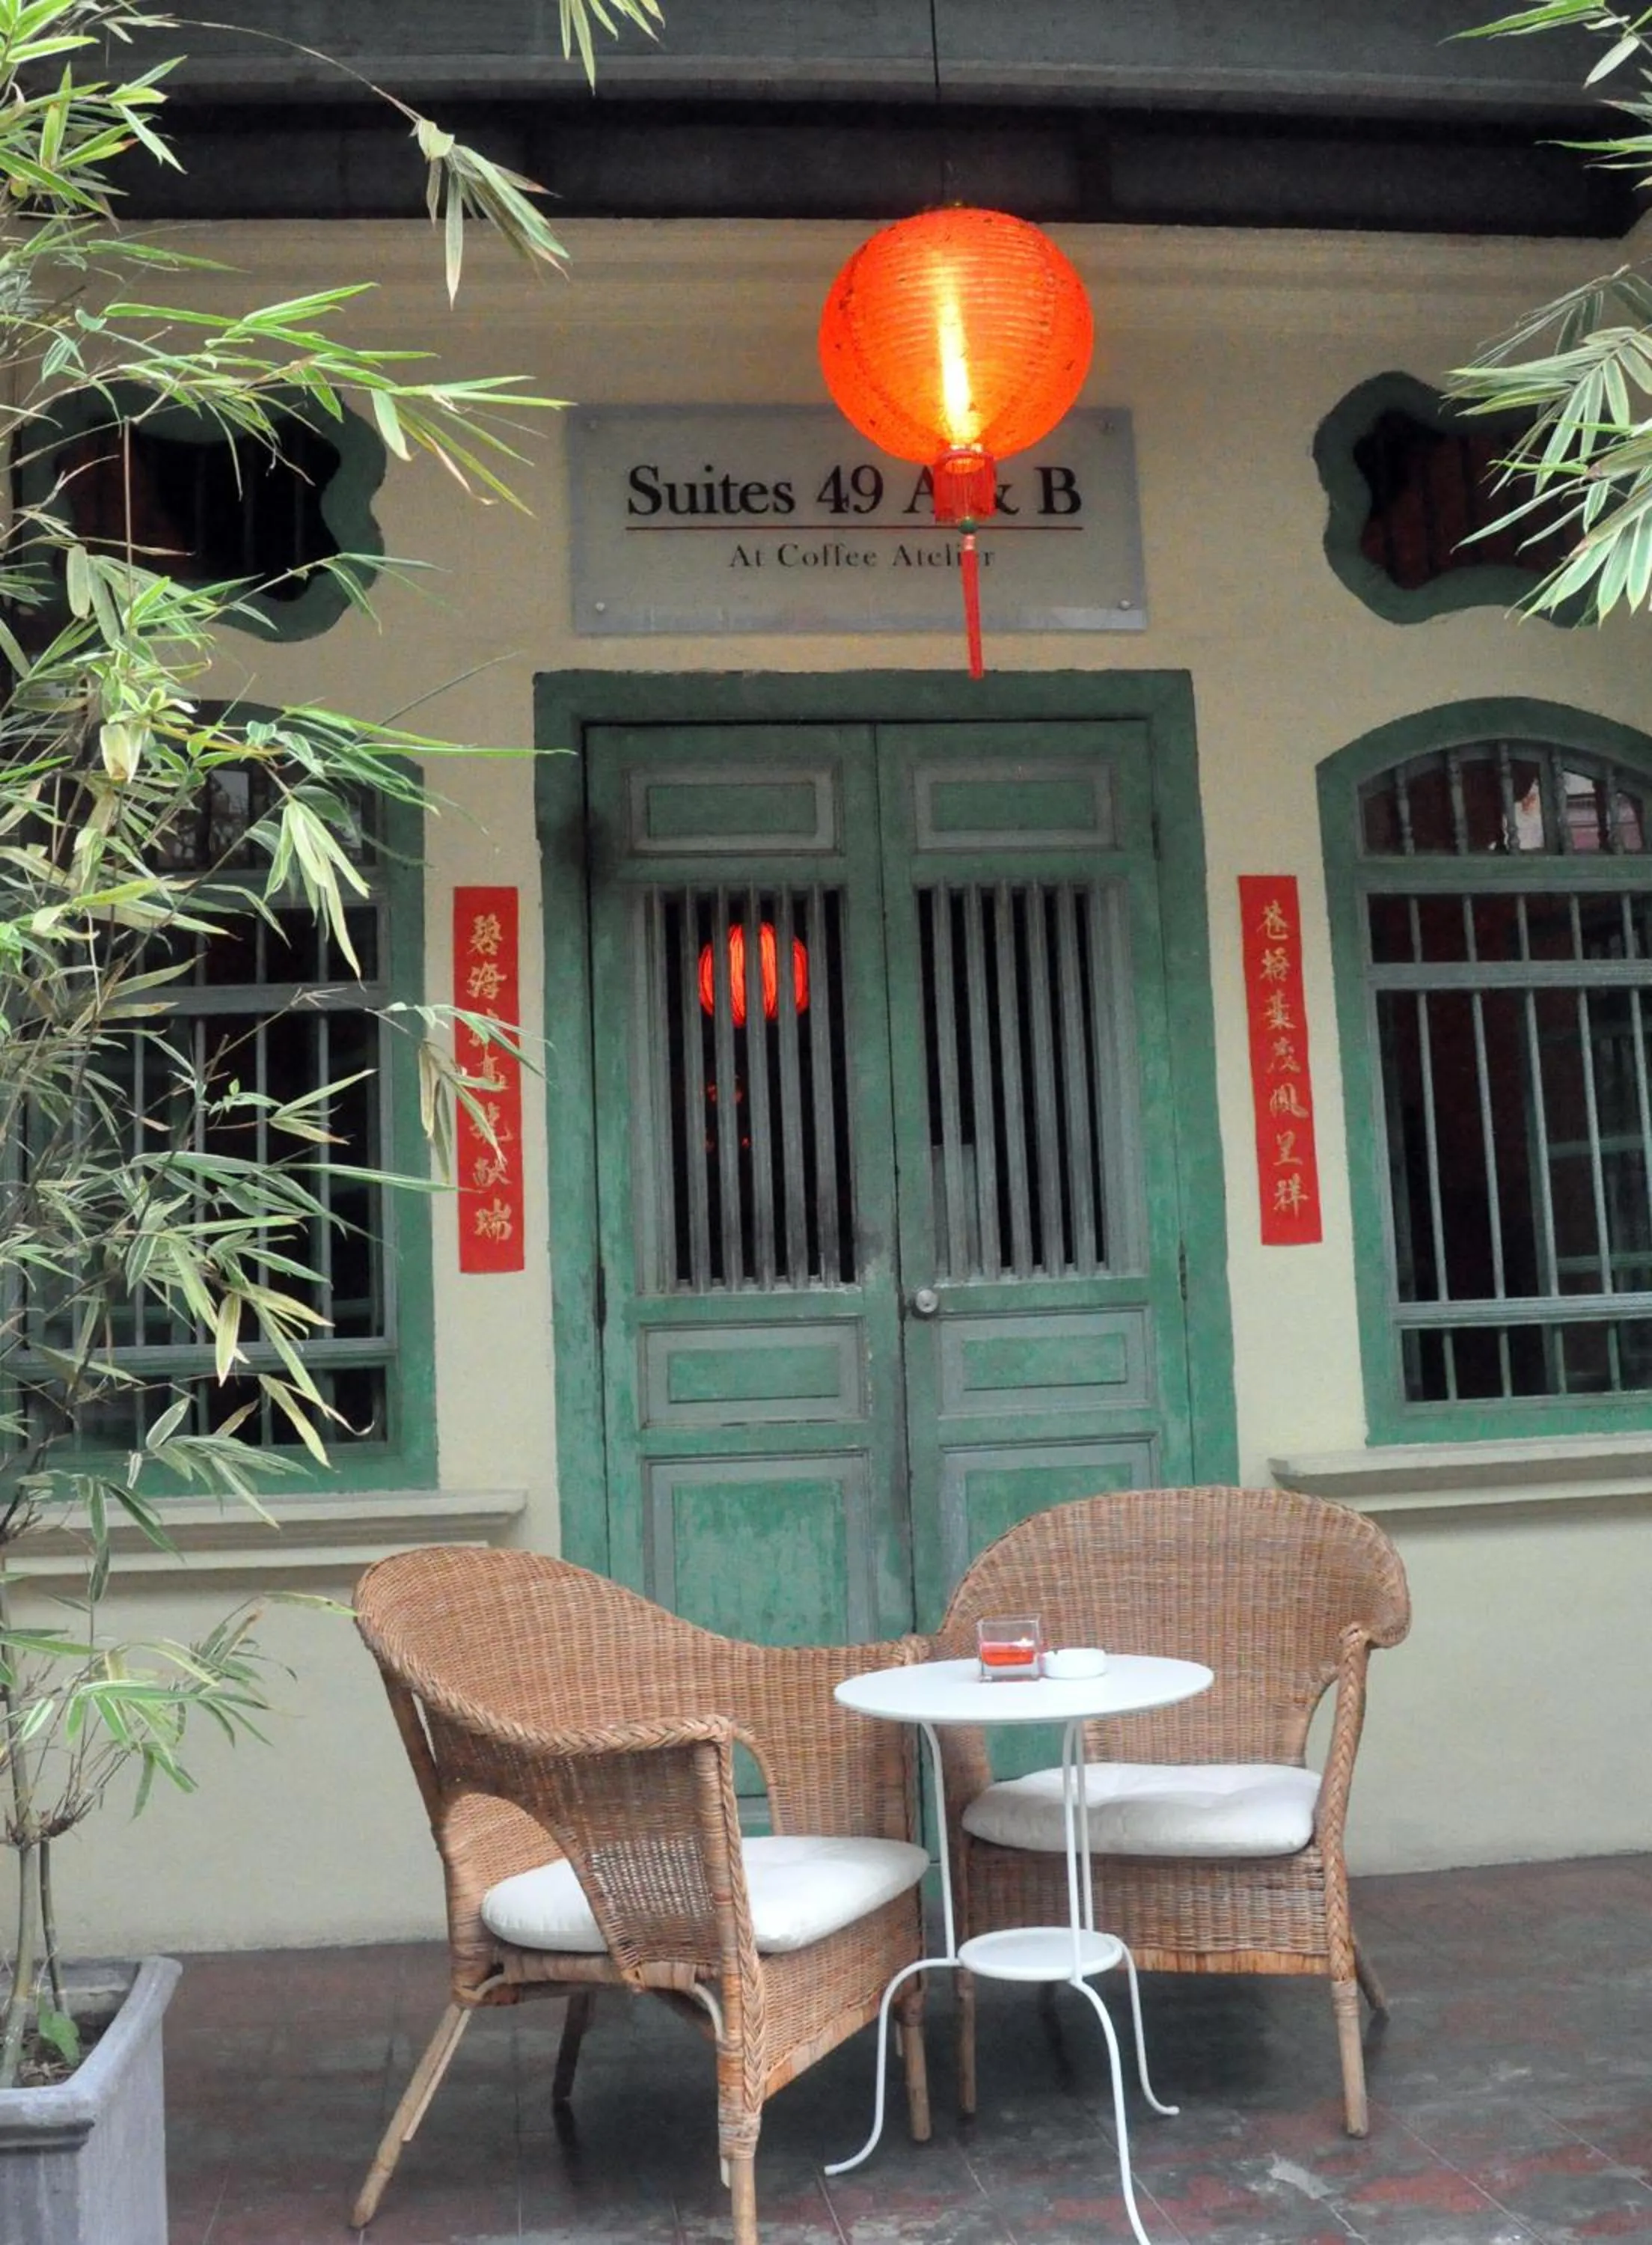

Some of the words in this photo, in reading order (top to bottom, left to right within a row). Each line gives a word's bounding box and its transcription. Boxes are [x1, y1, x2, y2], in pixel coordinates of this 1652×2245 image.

[627, 465, 794, 516] Suites
[816, 465, 884, 515] 49
[1034, 466, 1083, 514] B
[728, 545, 764, 568] At
[777, 542, 878, 568] Coffee
[893, 543, 995, 567] Atelir
